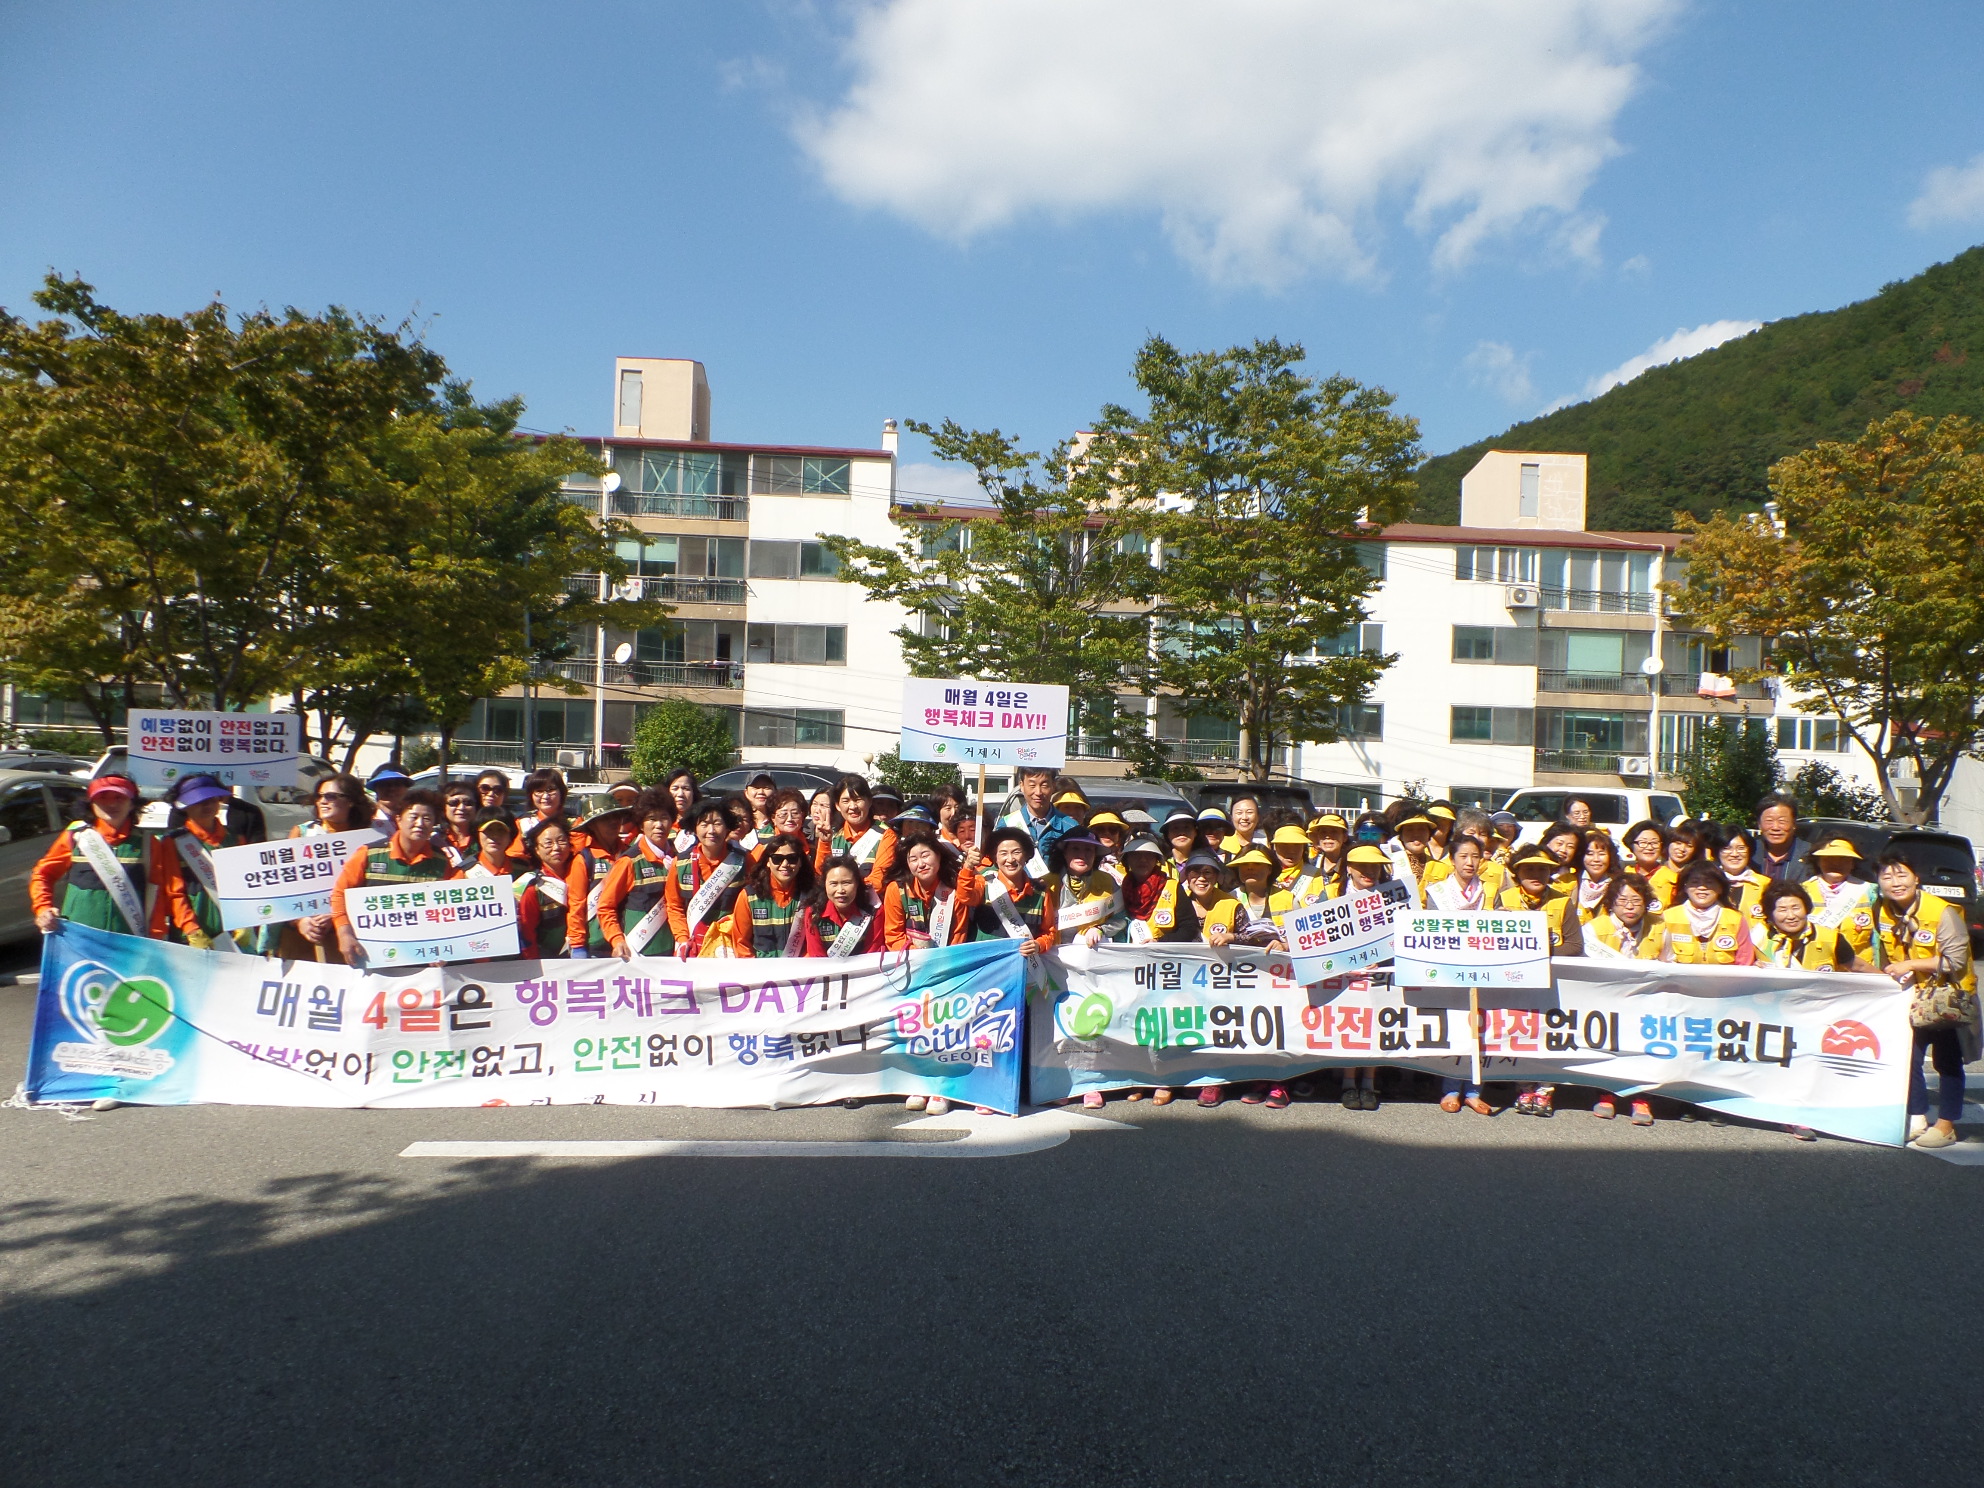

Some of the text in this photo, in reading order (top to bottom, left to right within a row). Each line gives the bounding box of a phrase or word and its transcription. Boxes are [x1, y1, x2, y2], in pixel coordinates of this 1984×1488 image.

[945, 689, 1028, 709] 매월 4일은
[141, 717, 211, 734] 예방없이
[925, 708, 1047, 730] 행복체크 DAY!!
[141, 736, 289, 753] 안전없이 행복없다.
[964, 747, 1001, 759] 거제시
[259, 840, 347, 866] 매월 4일은
[244, 861, 333, 889] 안전점검의
[364, 885, 496, 911] 생활주변 위험요인
[357, 903, 508, 929] 다시한번 확인합시다.
[1295, 904, 1352, 932] 예방없이
[1412, 918, 1532, 934] 생활주변 위험요인
[1299, 922, 1355, 951] 안전없이
[1404, 935, 1542, 950] 다시한번 확인합시다.
[415, 945, 454, 958] 거제시
[1348, 948, 1379, 964] 거제시
[1135, 962, 1182, 990] 매월
[1192, 962, 1258, 989] 4일은
[1455, 971, 1490, 982] 거제시
[257, 974, 850, 1032] 매월 4일은 행복체크 DAY!!
[889, 993, 972, 1034] Blue
[1135, 1004, 1797, 1068] 예방없이 안전없고 안전없이 행복없다
[392, 1042, 555, 1083] 안전없고,
[573, 1033, 714, 1072] 안전없이
[938, 1051, 989, 1064] GEOJE
